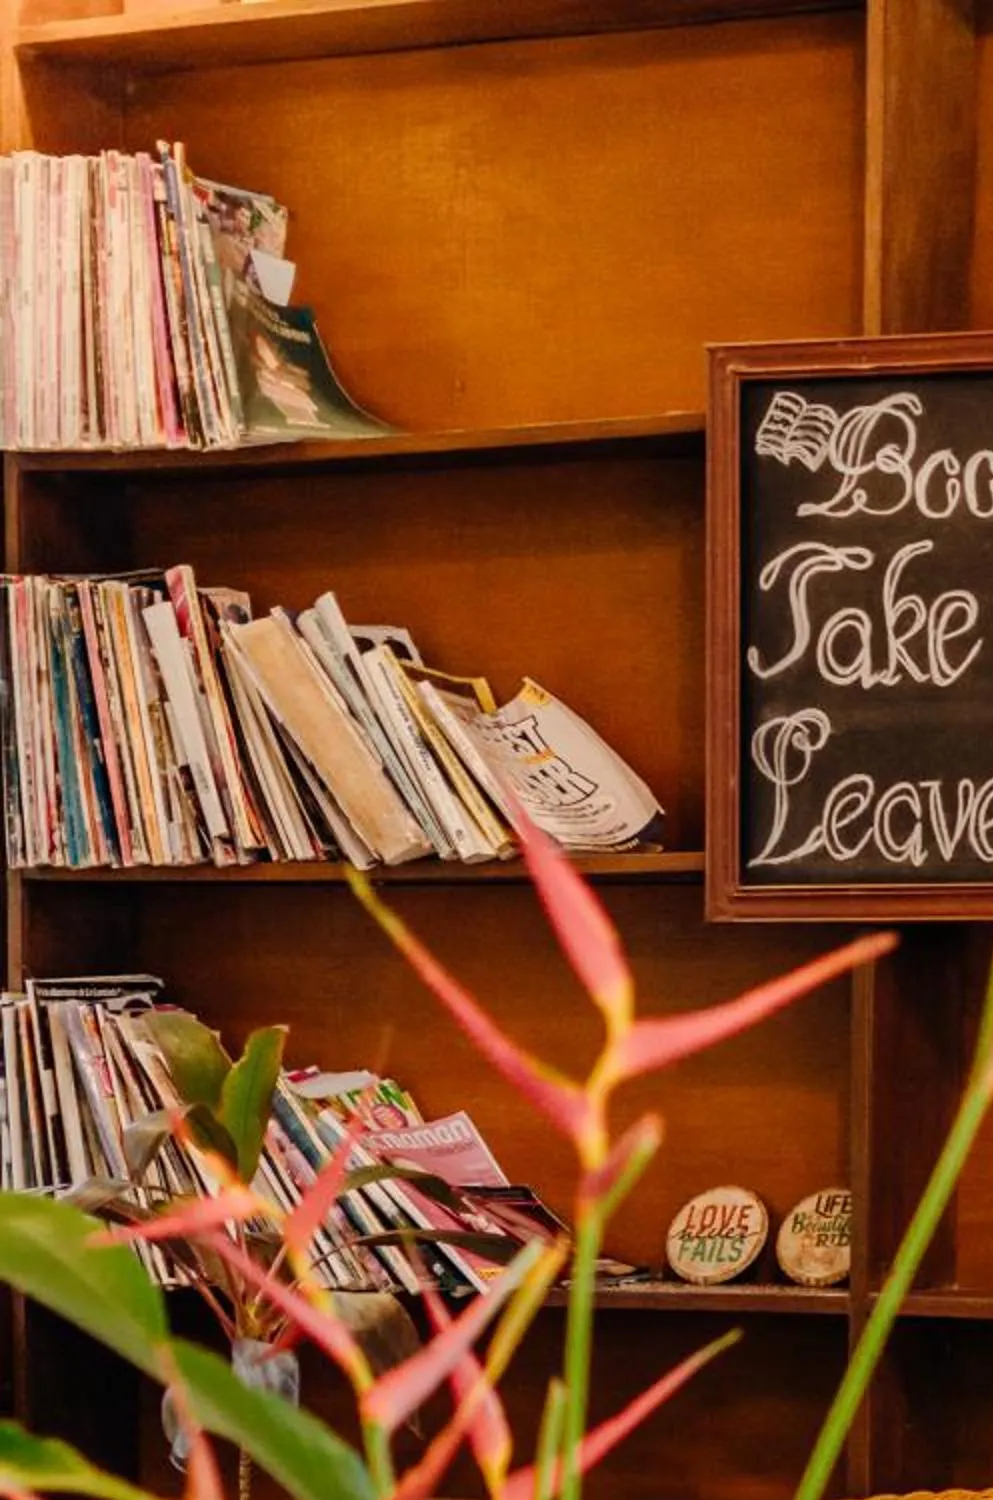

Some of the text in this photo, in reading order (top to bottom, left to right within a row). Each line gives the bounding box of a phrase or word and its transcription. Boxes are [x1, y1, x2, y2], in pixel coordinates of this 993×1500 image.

[747, 539, 985, 688] Take
[684, 1204, 753, 1233] LOVE
[677, 1236, 745, 1263] FAILS
